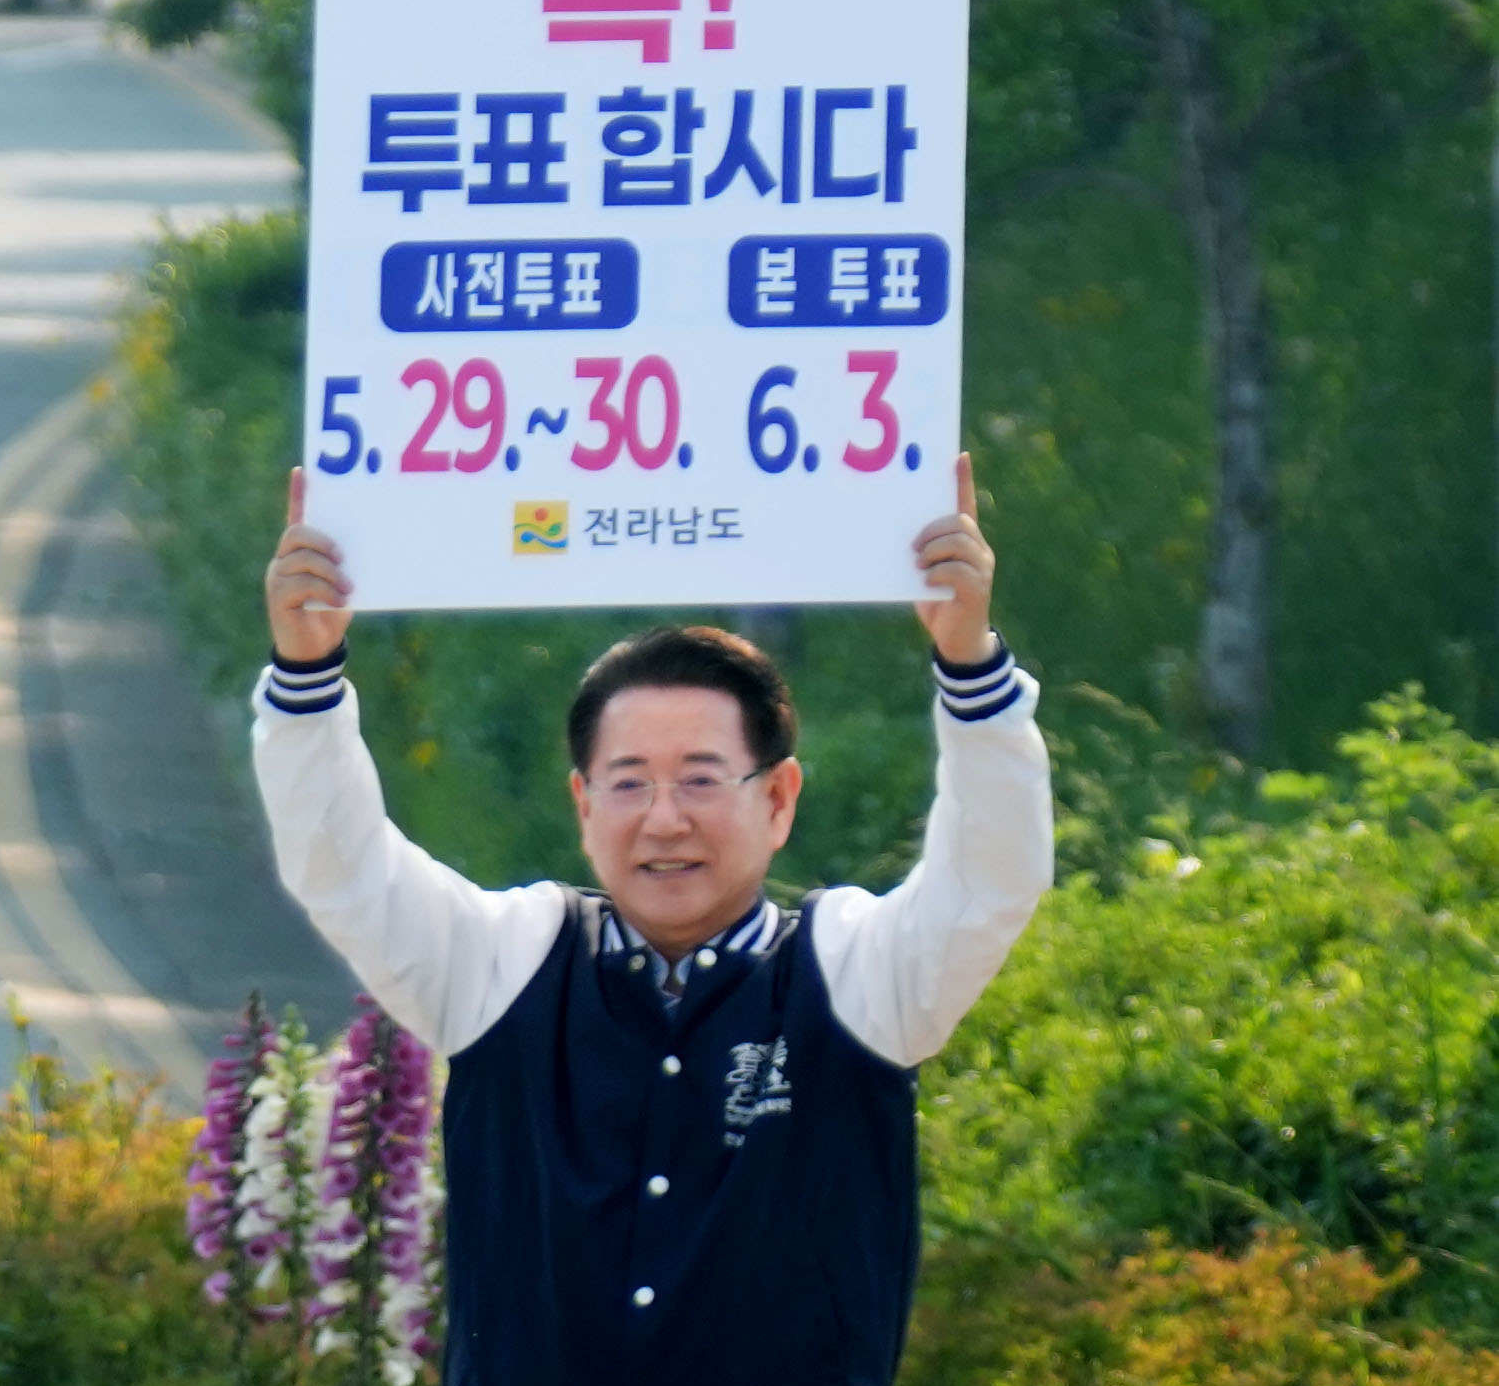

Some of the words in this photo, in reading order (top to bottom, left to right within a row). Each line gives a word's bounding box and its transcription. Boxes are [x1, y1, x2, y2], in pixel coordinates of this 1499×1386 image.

[362, 93, 569, 212] 투표
[599, 85, 916, 206] 합시다
[417, 252, 601, 319] 사전투표
[756, 248, 796, 314] 본
[829, 248, 920, 314] 투표
[585, 507, 743, 546] 전라남도
